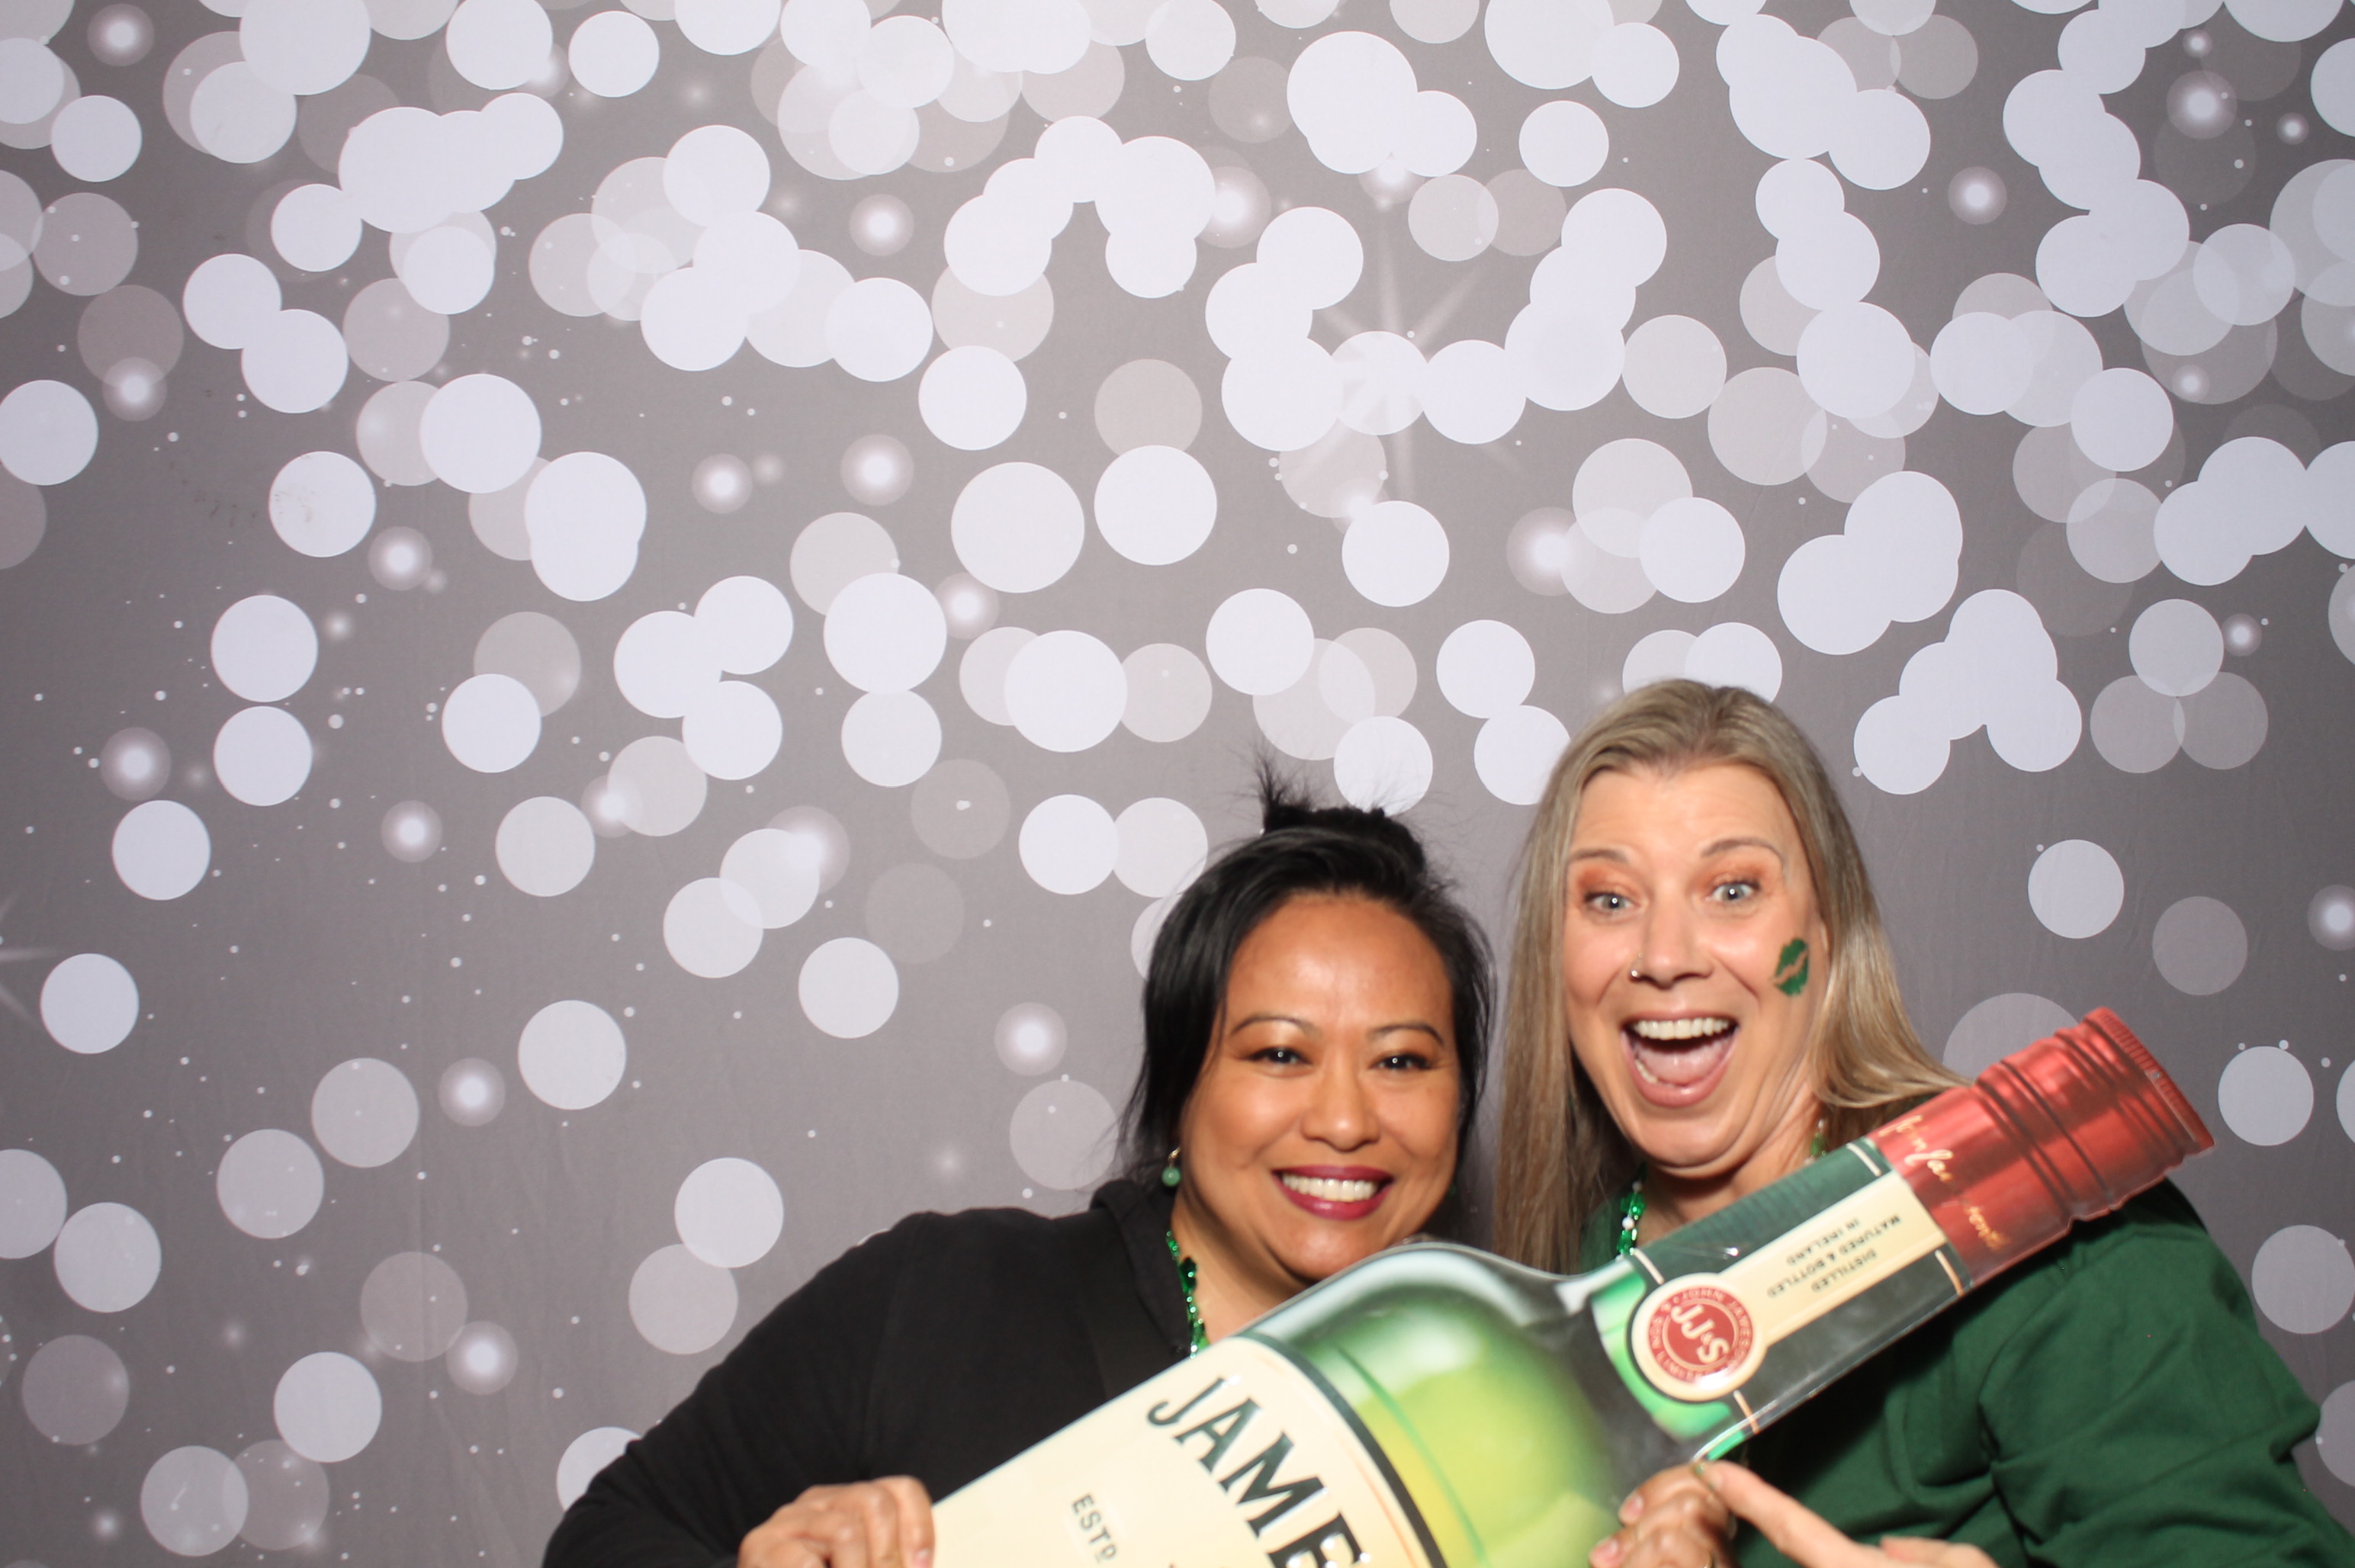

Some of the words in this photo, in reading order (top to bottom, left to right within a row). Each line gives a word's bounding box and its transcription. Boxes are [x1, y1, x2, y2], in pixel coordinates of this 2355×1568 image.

[1839, 1213, 1900, 1255] MATURED
[1845, 1218, 1860, 1231] IN
[1786, 1227, 1843, 1266] IRELAND
[1766, 1258, 1825, 1299] BOTTLED
[1811, 1247, 1878, 1293] DISTILLED
